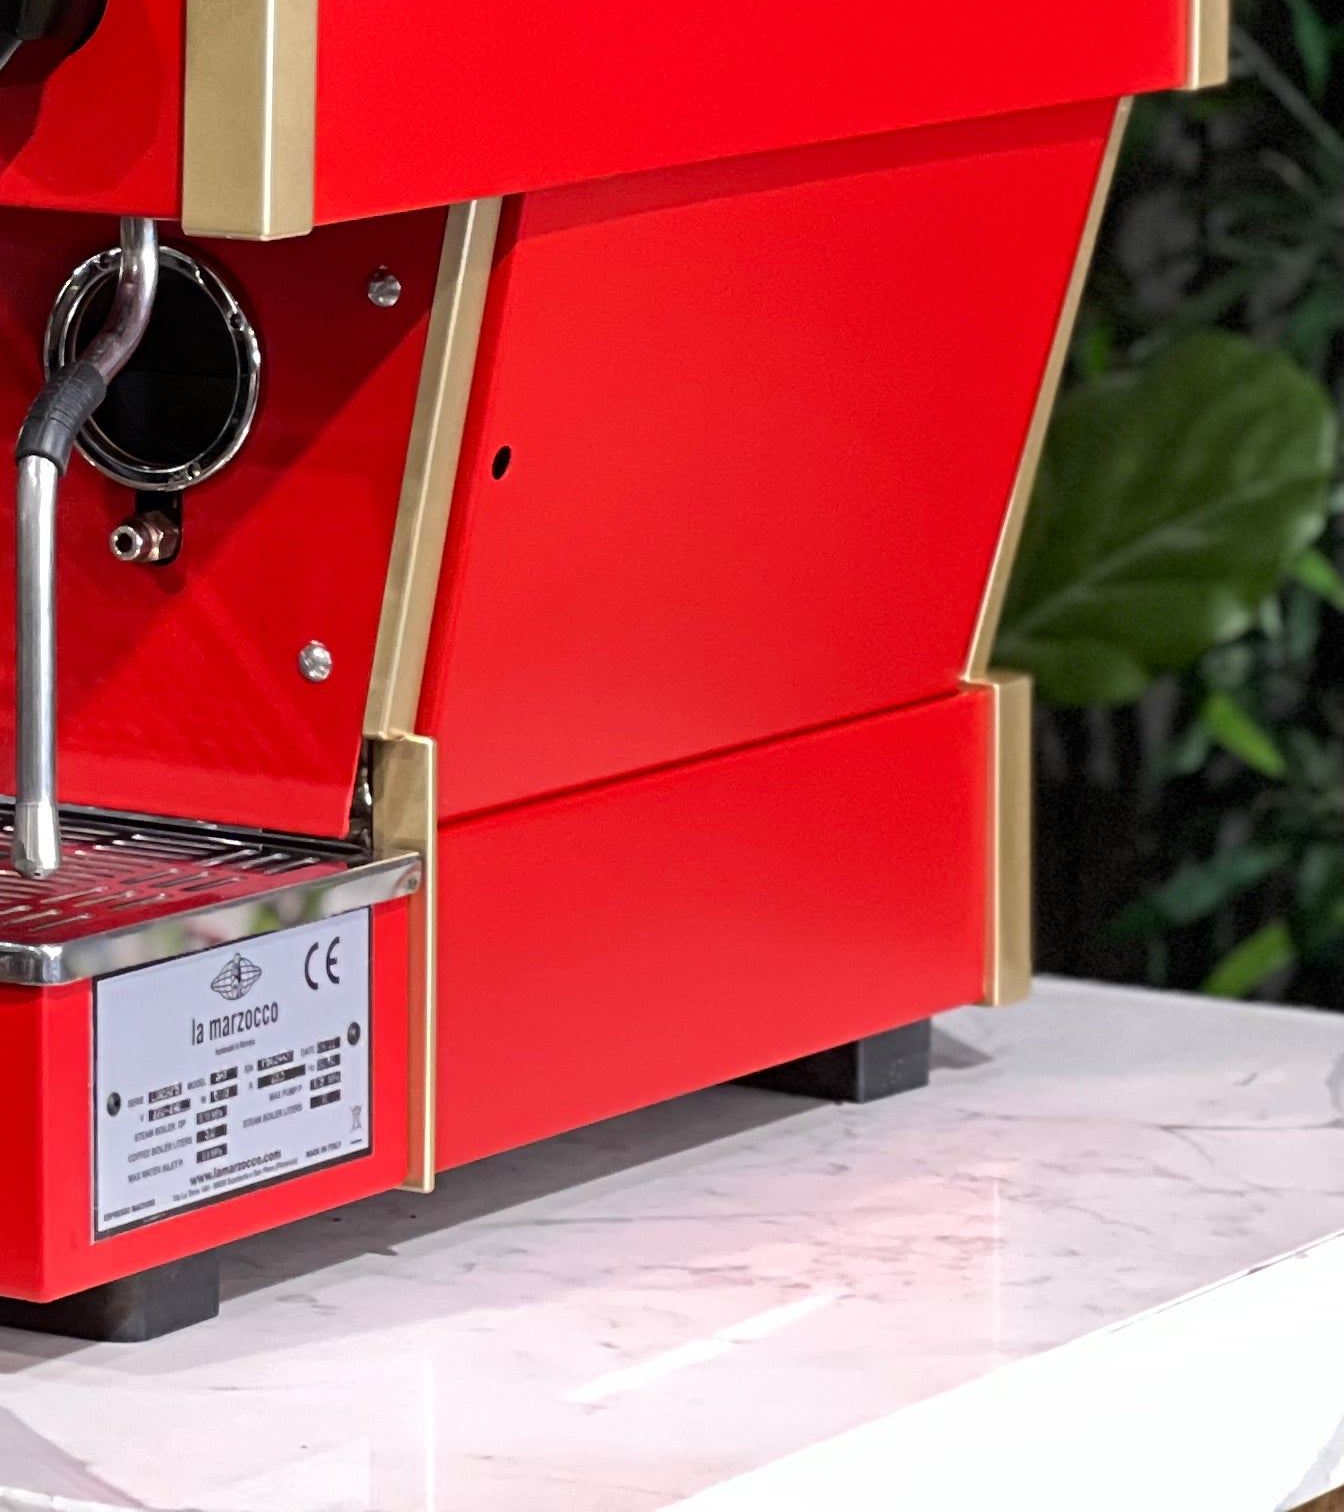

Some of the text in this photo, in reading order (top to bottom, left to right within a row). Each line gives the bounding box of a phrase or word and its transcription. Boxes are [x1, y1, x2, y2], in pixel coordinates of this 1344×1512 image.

[304, 935, 341, 991] CE
[191, 1001, 279, 1046] la marzocco
[189, 1148, 281, 1187] www.lamarzocco.com
